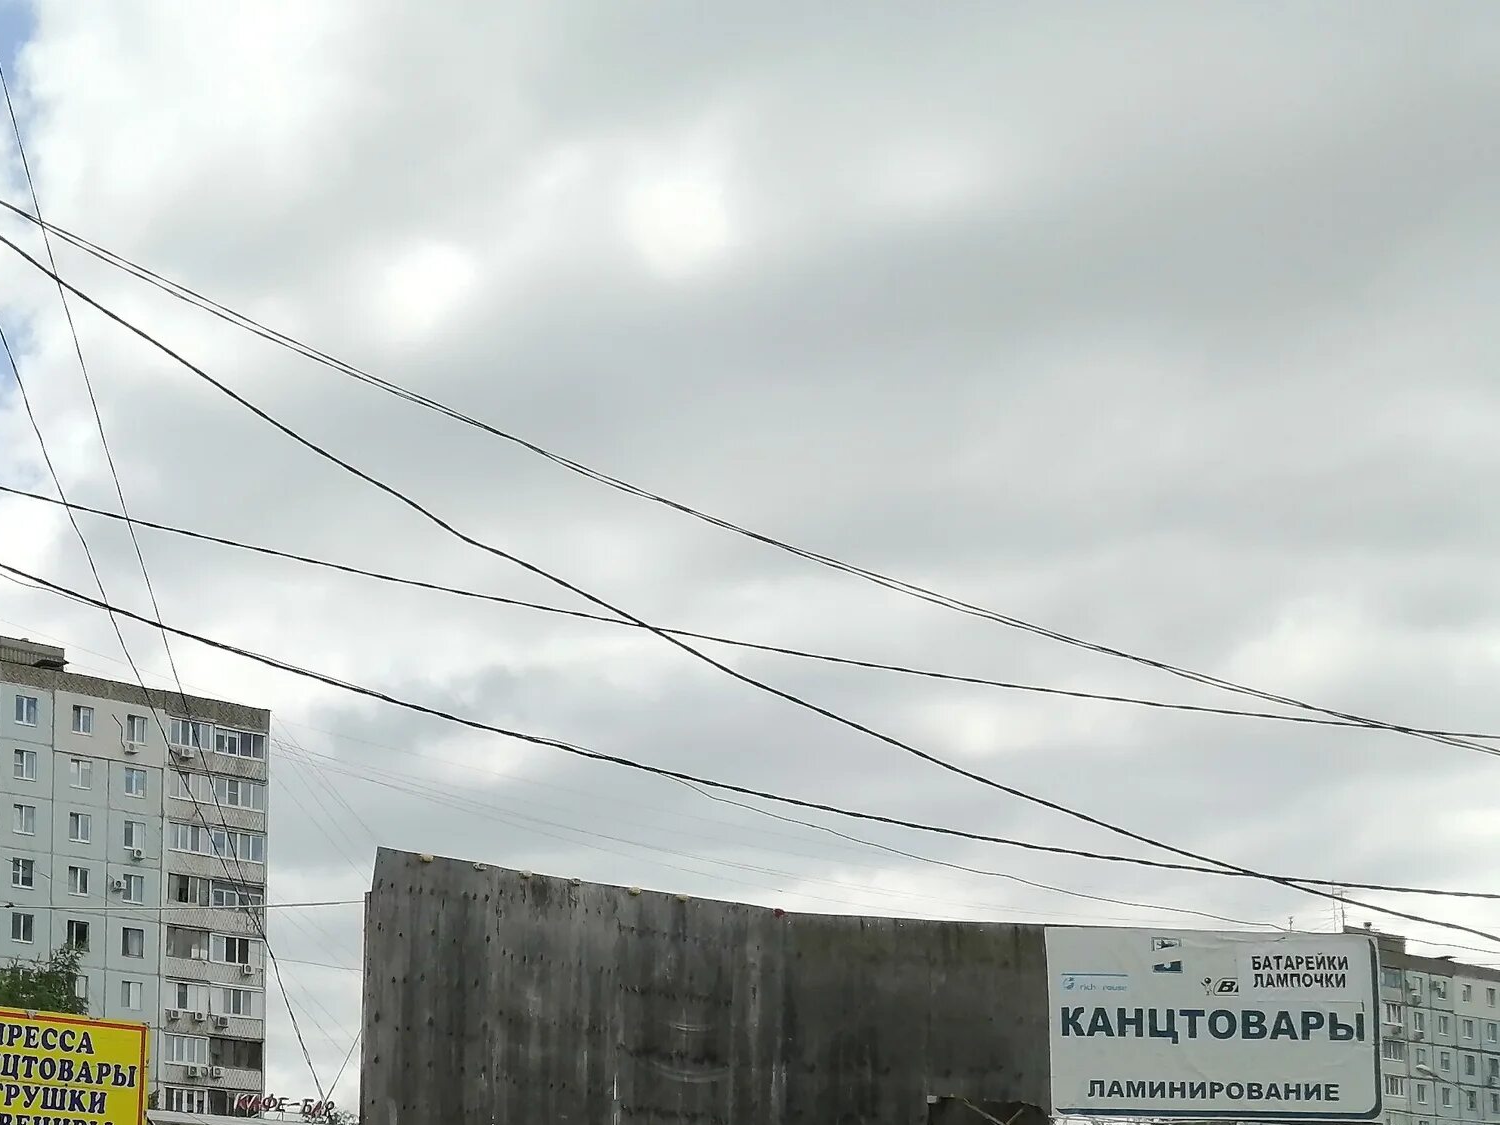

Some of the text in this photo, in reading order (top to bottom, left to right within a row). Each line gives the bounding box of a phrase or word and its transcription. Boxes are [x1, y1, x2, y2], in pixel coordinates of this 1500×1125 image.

[1251, 953, 1349, 972] БАТАРЕЙКИ
[1216, 980, 1239, 993] B
[1253, 972, 1347, 990] ЛАМПОЧКИ
[1061, 1006, 1365, 1043] КАНЦТОВАРЫ
[1088, 1080, 1340, 1102] ЛАМИНИРОВАНИЕ
